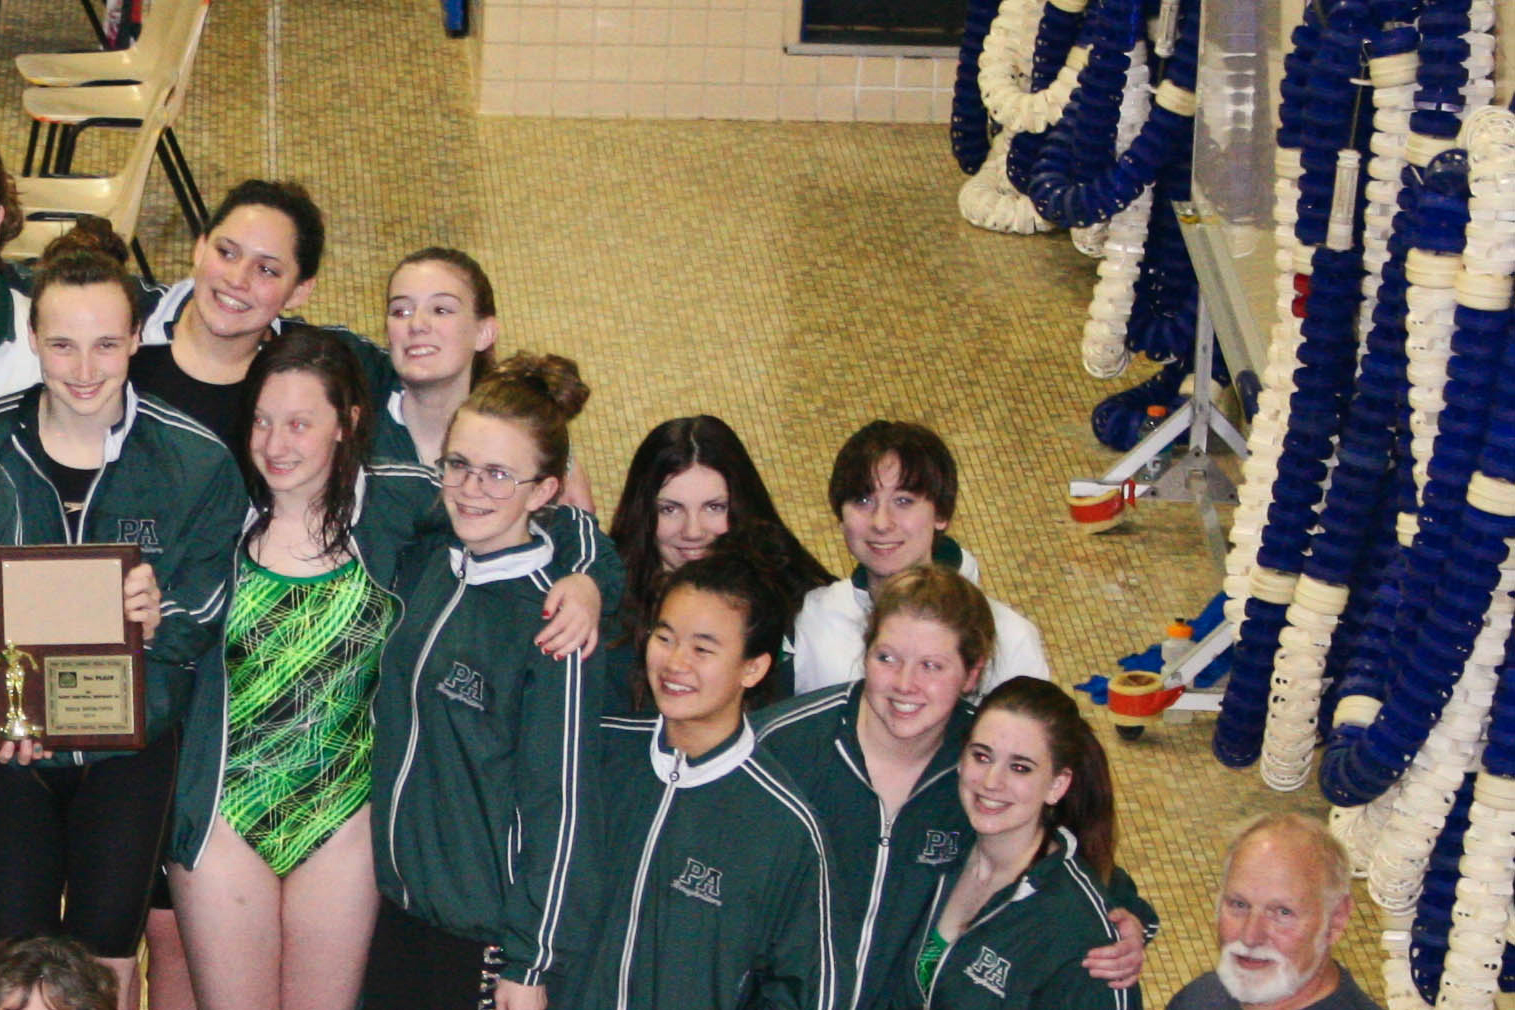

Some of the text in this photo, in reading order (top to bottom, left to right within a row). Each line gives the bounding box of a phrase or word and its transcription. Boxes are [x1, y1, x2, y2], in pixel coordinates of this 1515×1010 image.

[117, 519, 159, 545] PA
[444, 661, 484, 701] PA
[679, 857, 723, 897] PA
[971, 945, 1012, 988] PA
